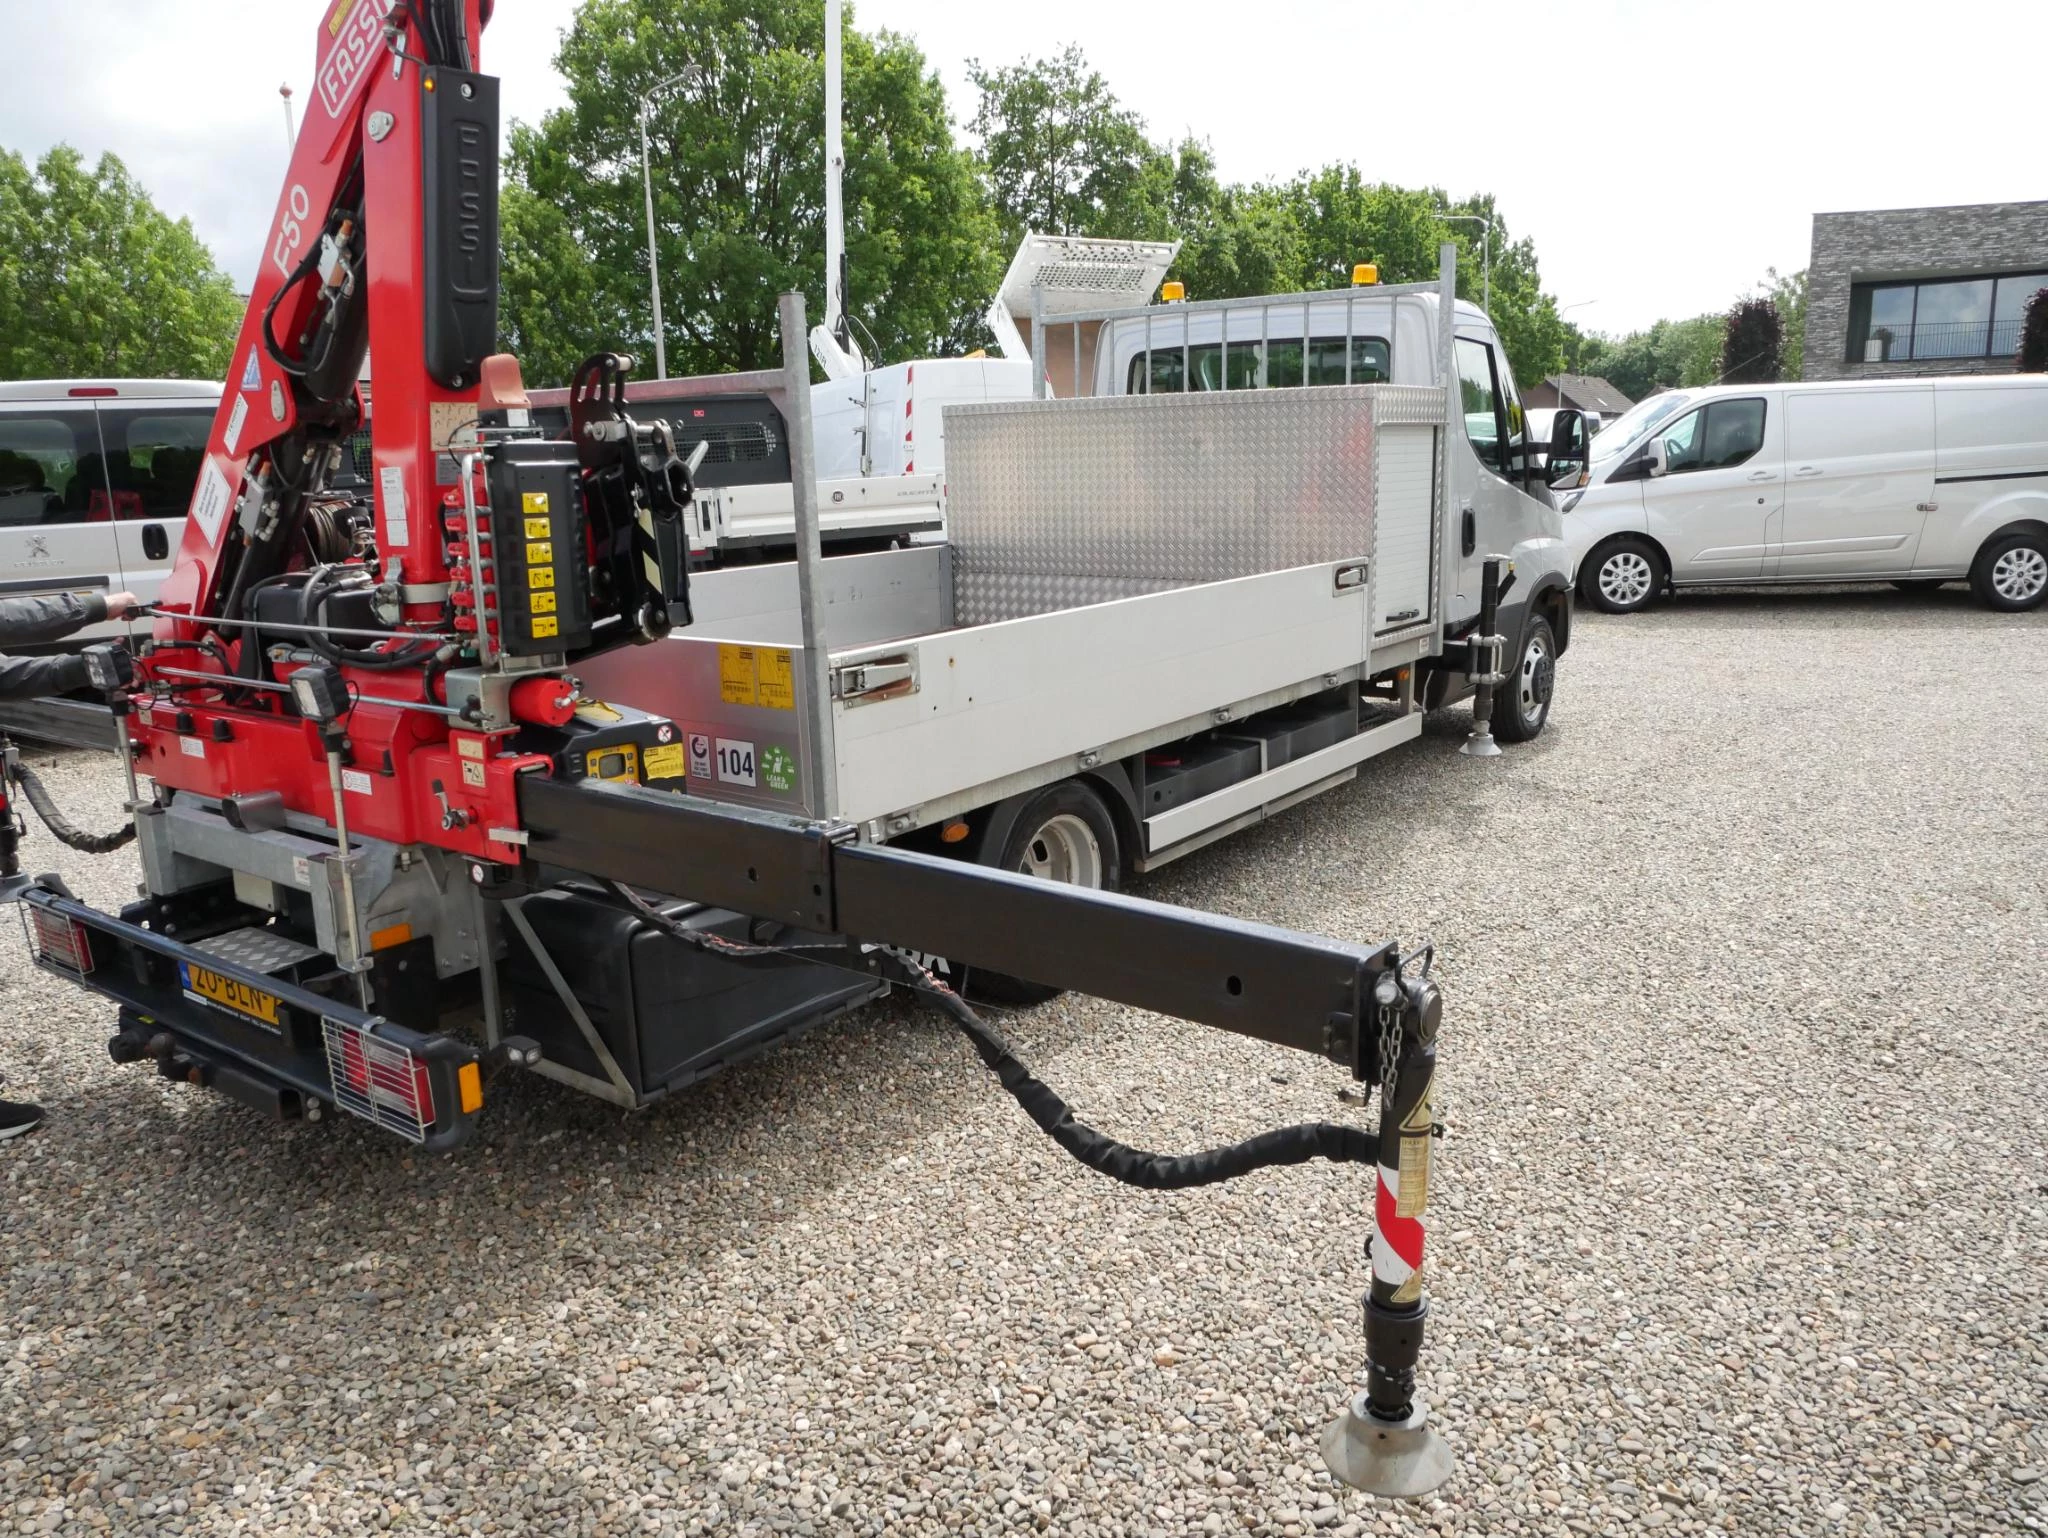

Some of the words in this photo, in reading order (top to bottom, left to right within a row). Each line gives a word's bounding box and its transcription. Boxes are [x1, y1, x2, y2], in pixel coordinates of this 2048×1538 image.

[273, 184, 309, 279] F50
[459, 126, 480, 284] FASSI
[718, 747, 754, 778] 104
